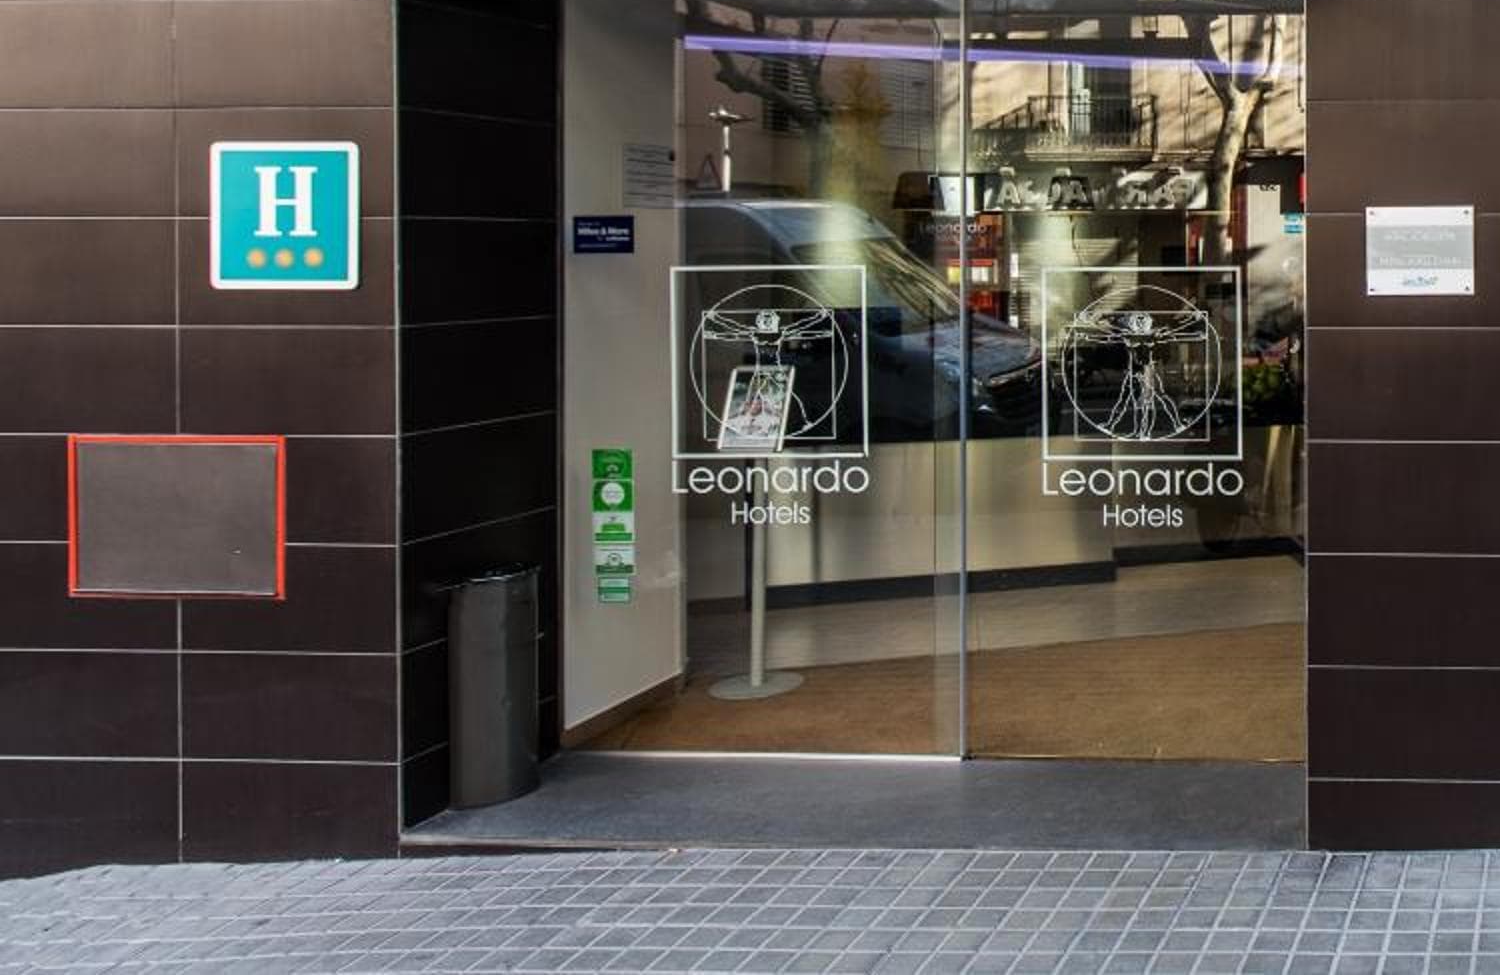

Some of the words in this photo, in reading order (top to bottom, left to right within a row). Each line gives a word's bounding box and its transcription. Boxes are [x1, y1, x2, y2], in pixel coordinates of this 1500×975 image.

[253, 166, 318, 237] H
[671, 459, 870, 494] Leonardo
[1042, 462, 1244, 496] Leonardo
[731, 501, 811, 525] Hotels
[1103, 504, 1184, 527] Hotels
